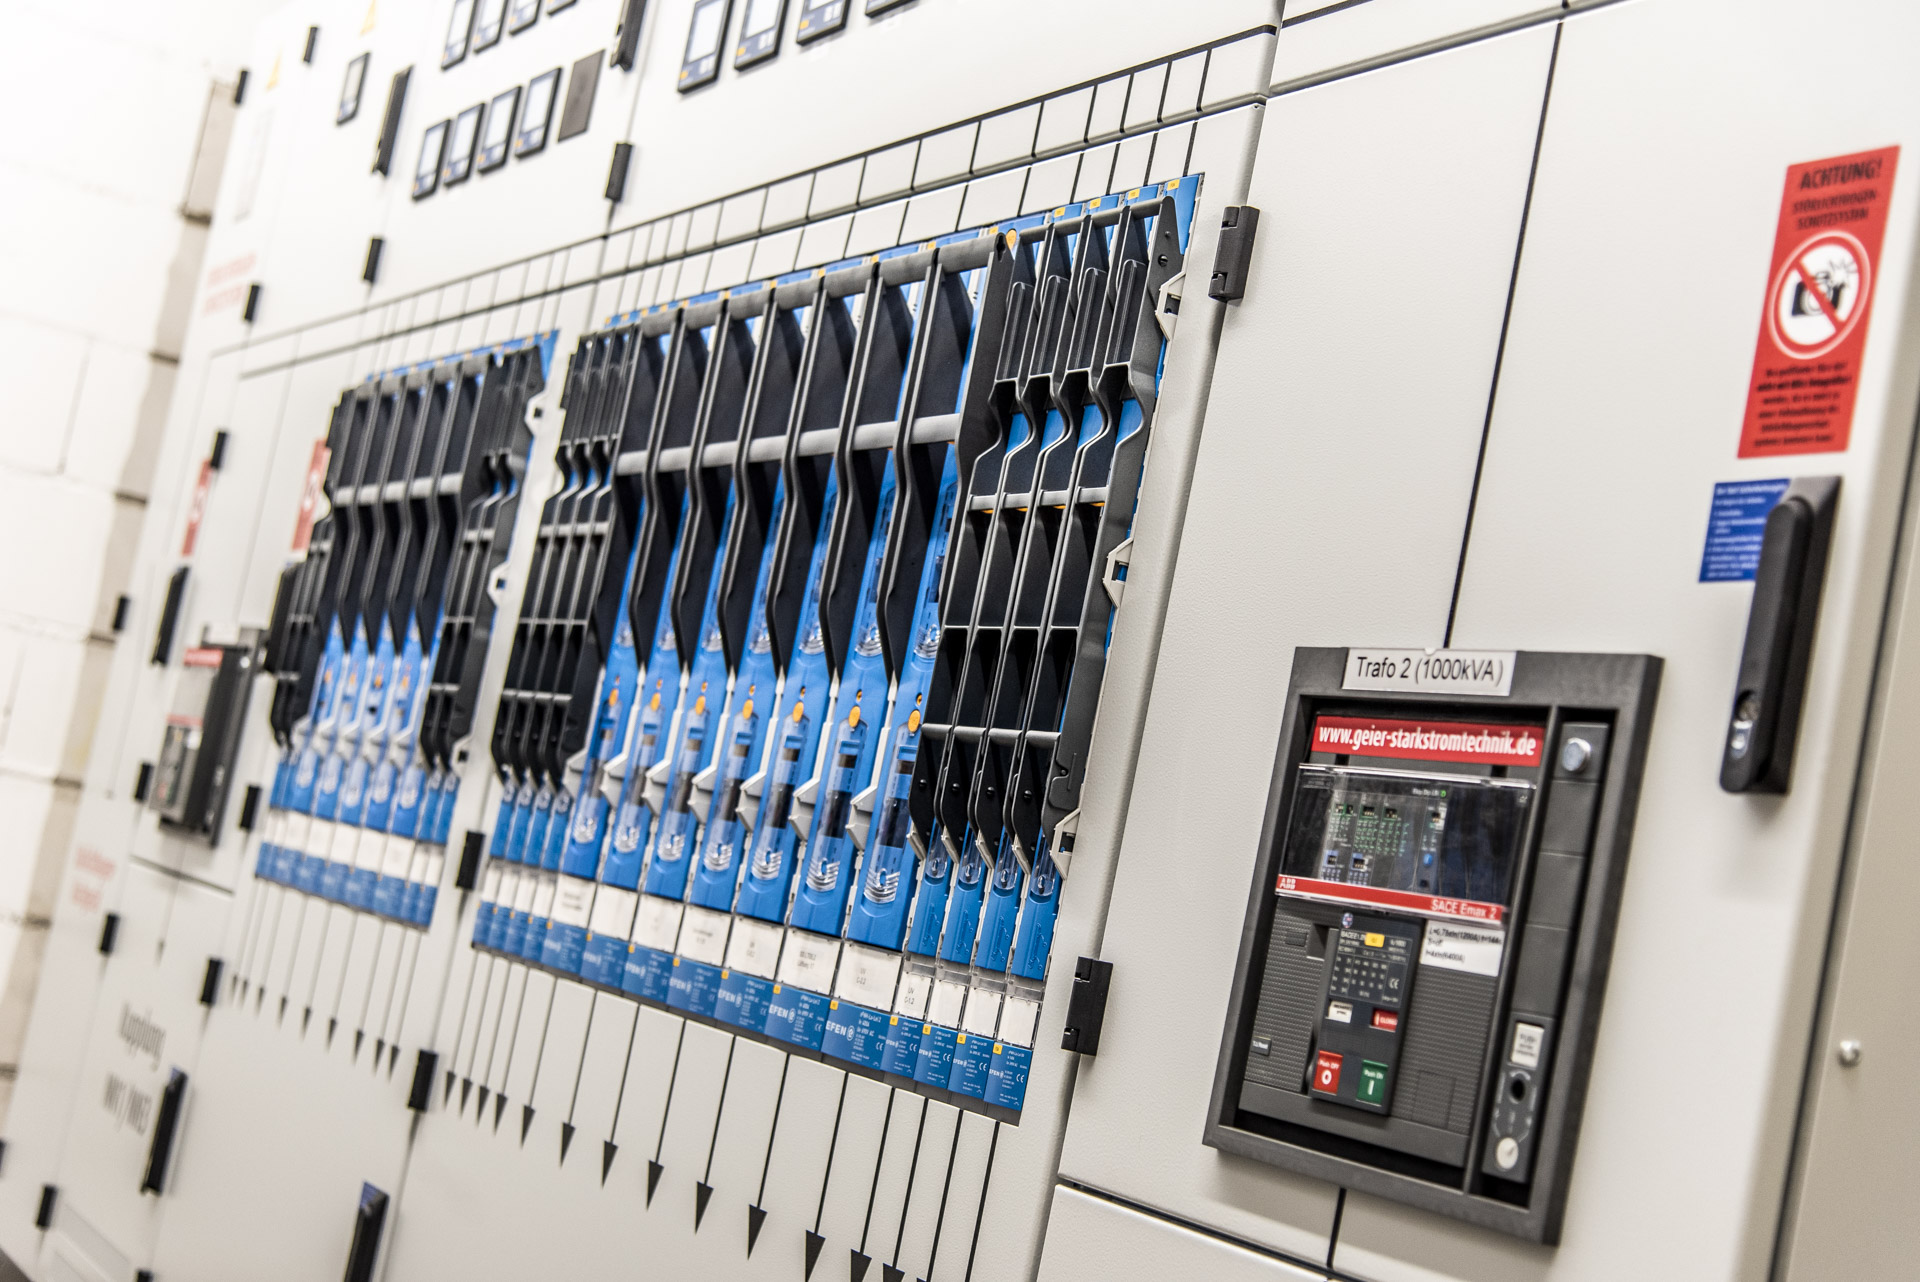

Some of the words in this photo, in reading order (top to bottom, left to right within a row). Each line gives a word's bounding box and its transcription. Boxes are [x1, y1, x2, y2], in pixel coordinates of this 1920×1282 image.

[1800, 158, 1883, 190] ACHTUNG!
[1357, 656, 1396, 678] Trafo
[1400, 657, 1411, 679] 2
[1415, 657, 1503, 688] (1000kVA)
[1319, 724, 1537, 756] www.geier-starkstromtechnik.de
[1280, 877, 1296, 890] ABB
[1431, 898, 1459, 915] SACE
[1460, 902, 1487, 918] Emax
[1489, 906, 1498, 919] 2
[769, 1004, 789, 1019] EFEN
[825, 1020, 847, 1036] EFEN
